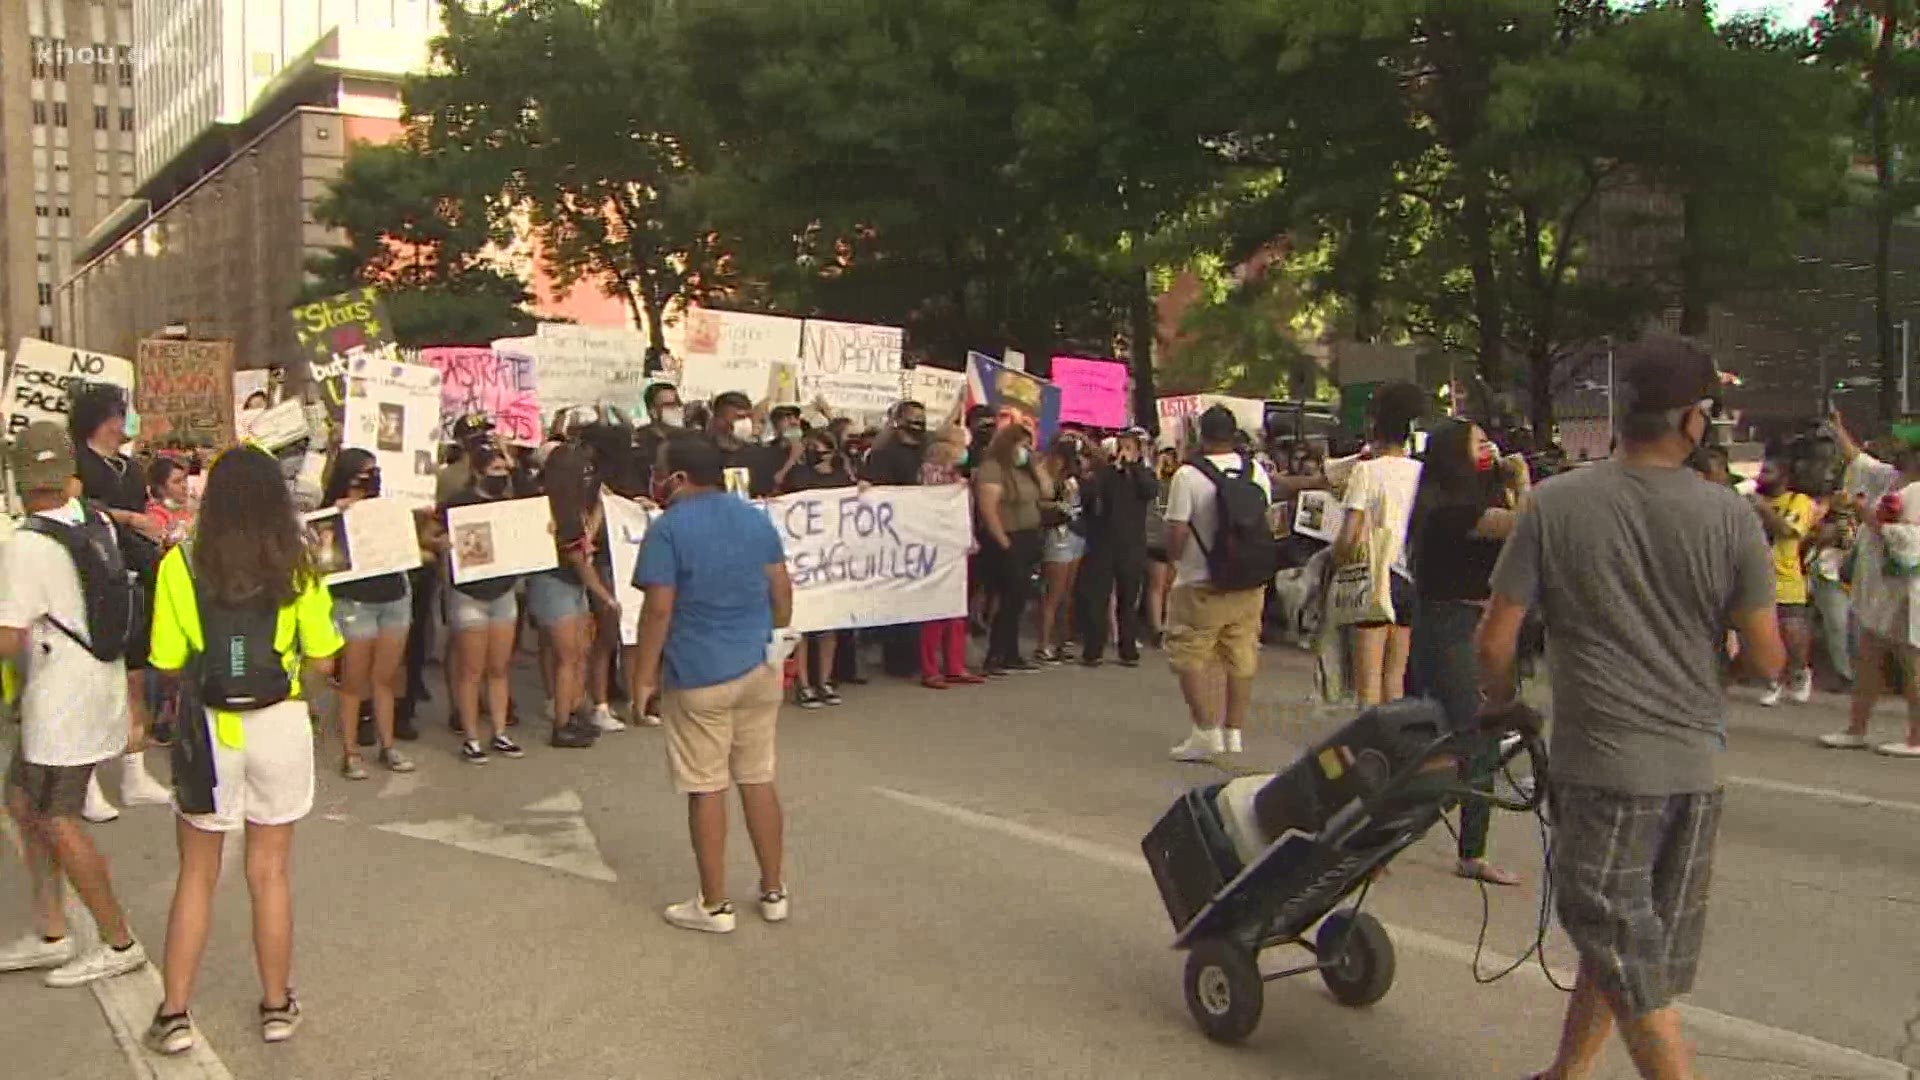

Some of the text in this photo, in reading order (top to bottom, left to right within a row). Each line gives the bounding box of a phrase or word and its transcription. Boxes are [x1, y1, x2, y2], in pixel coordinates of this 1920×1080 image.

[305, 300, 371, 332] Stars
[69, 351, 104, 375] NO
[806, 325, 842, 374] NO
[14, 363, 69, 391] FORG
[784, 497, 901, 546] CE FOR
